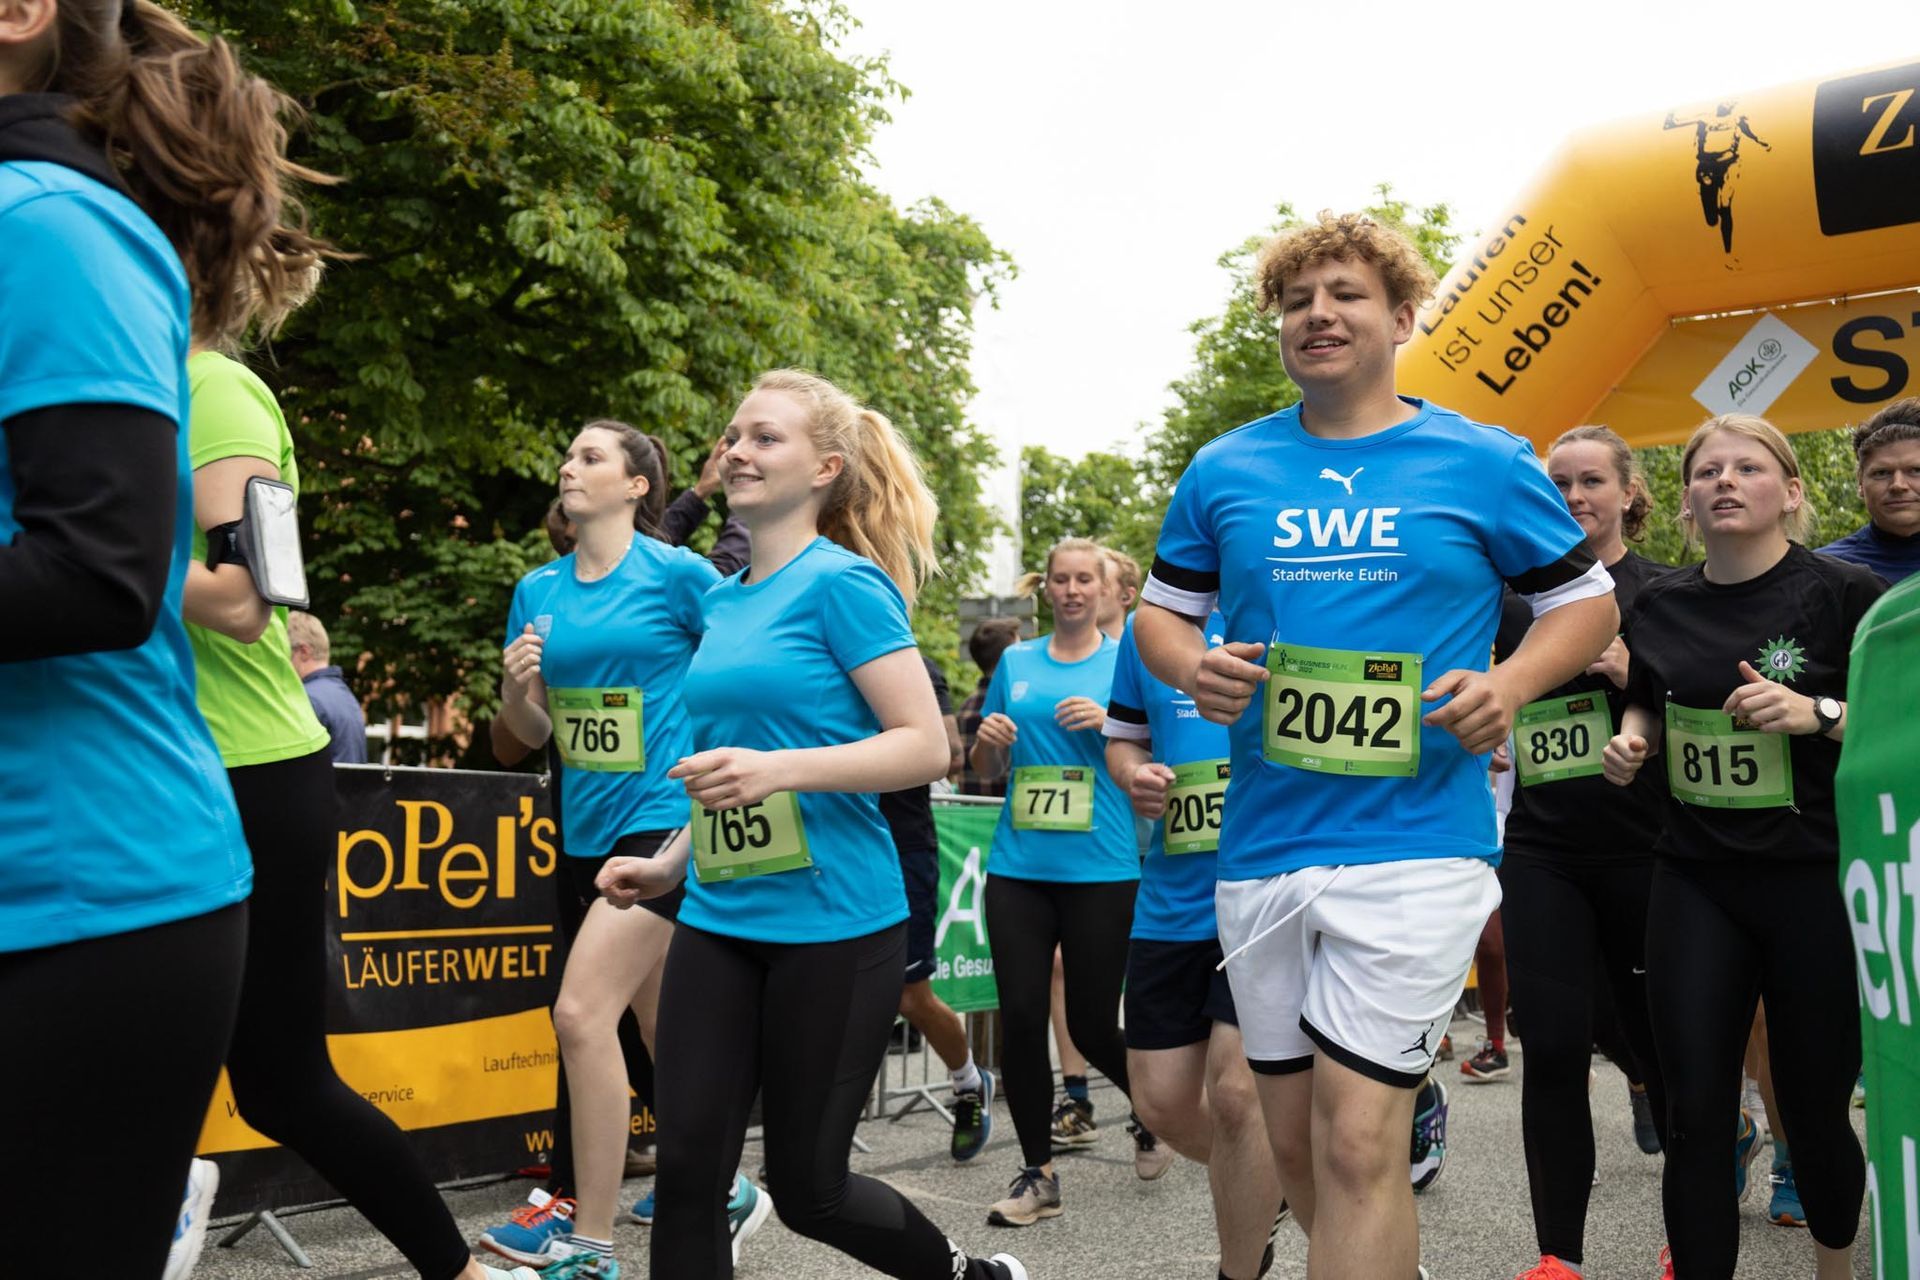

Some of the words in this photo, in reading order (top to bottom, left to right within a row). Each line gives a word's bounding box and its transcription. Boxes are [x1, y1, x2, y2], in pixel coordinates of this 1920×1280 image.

[1860, 88, 1915, 155] Z
[1433, 326, 1482, 372] ist
[1478, 225, 1563, 324] unser
[1476, 260, 1602, 395] Leben!
[1728, 356, 1765, 401] AOK
[1830, 311, 1920, 404] S
[1273, 507, 1401, 548] SWE
[1272, 568, 1354, 582] Stadtwerke
[1359, 568, 1398, 582] Eutin
[565, 717, 620, 753] 766
[1277, 688, 1402, 749] 2042
[1530, 723, 1590, 765] 830
[1683, 742, 1759, 786] 815
[1027, 788, 1070, 815] 771
[1169, 792, 1225, 834] 205
[703, 801, 771, 855] 765
[934, 846, 987, 949] A
[343, 945, 552, 989] LÄUFERWELT
[361, 1084, 414, 1103] ervice
